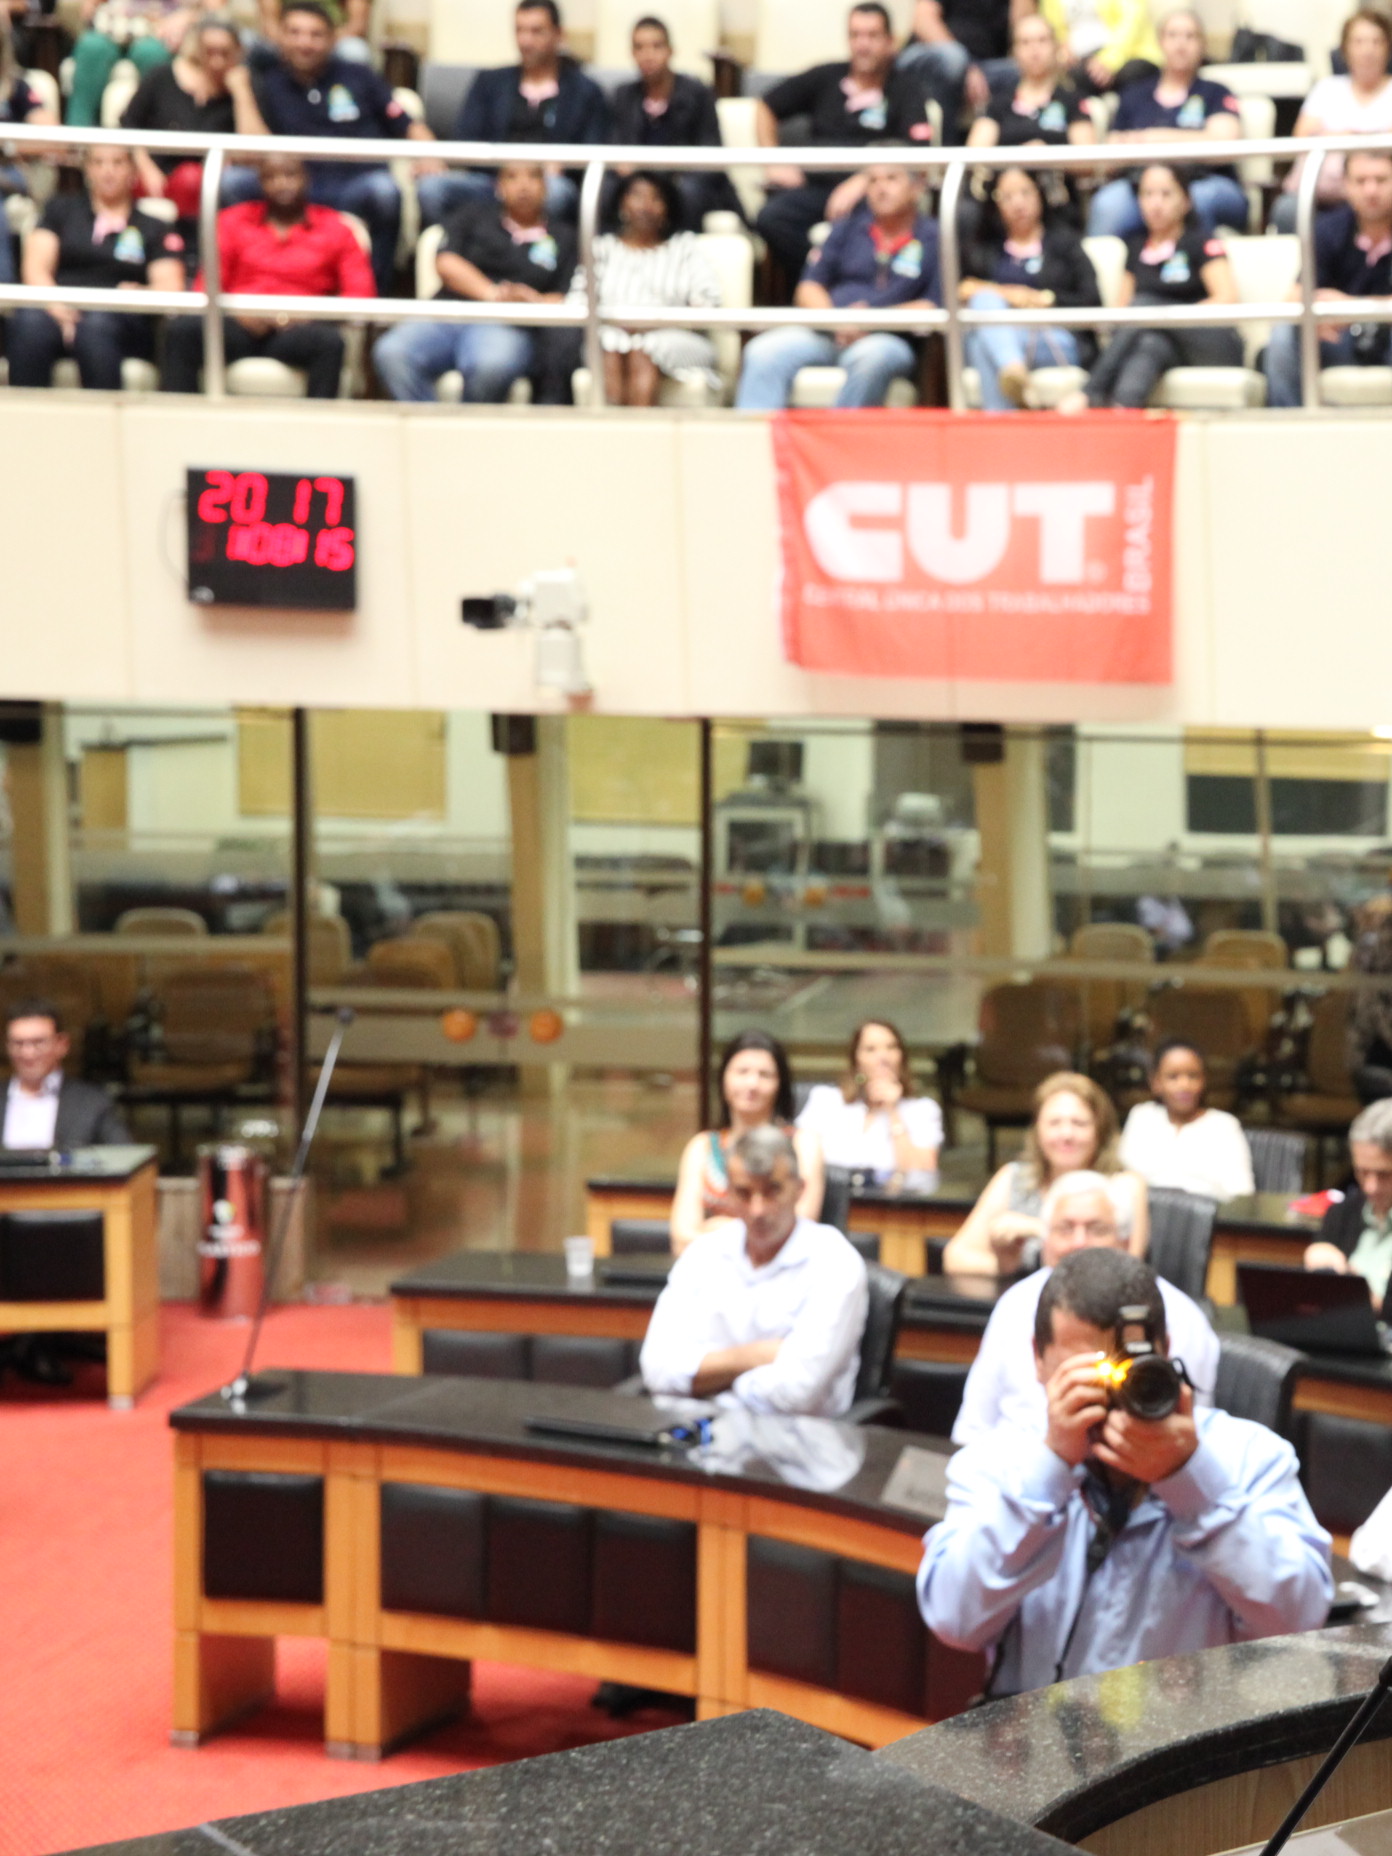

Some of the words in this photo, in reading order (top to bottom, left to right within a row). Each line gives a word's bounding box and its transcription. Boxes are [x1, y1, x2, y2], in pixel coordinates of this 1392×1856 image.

[197, 469, 269, 525] 20
[292, 476, 345, 527] 17
[804, 480, 1116, 584] CUT
[1122, 472, 1155, 592] BRASIL
